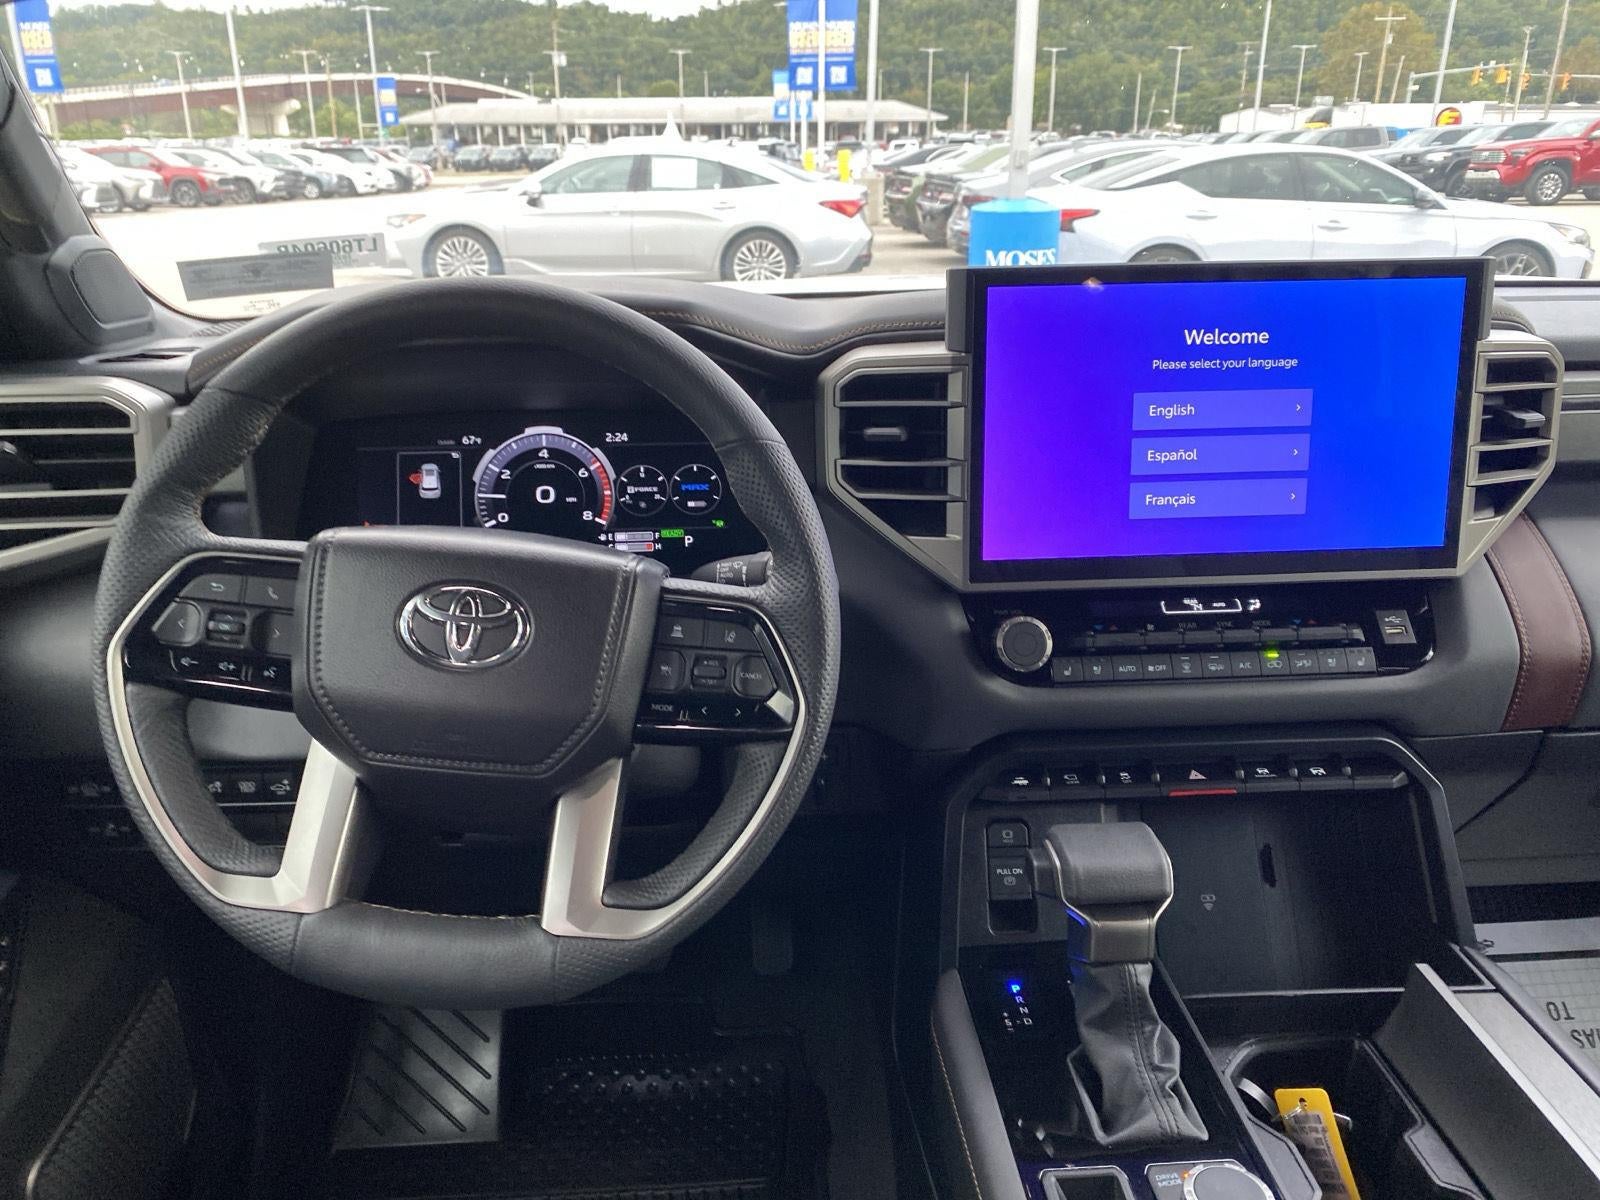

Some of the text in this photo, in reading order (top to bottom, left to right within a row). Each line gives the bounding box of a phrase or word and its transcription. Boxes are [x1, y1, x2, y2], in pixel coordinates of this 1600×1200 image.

[985, 248, 1056, 266] MOSES
[1184, 328, 1269, 345] Welcome
[1152, 357, 1298, 370] Please select your language
[1149, 404, 1195, 419] English
[606, 433, 629, 442] 2:24
[538, 449, 549, 459] 4
[1147, 448, 1197, 464] Español
[500, 469, 511, 479] 2
[578, 468, 589, 478] 6
[680, 483, 710, 491] MAX
[536, 485, 555, 504] 0
[1145, 493, 1196, 508] Français
[498, 512, 509, 522] 0
[583, 510, 593, 520] 8
[684, 535, 694, 547] P
[651, 703, 673, 712] MODE
[1011, 984, 1020, 993] P
[1546, 1001, 1575, 1022] TO
